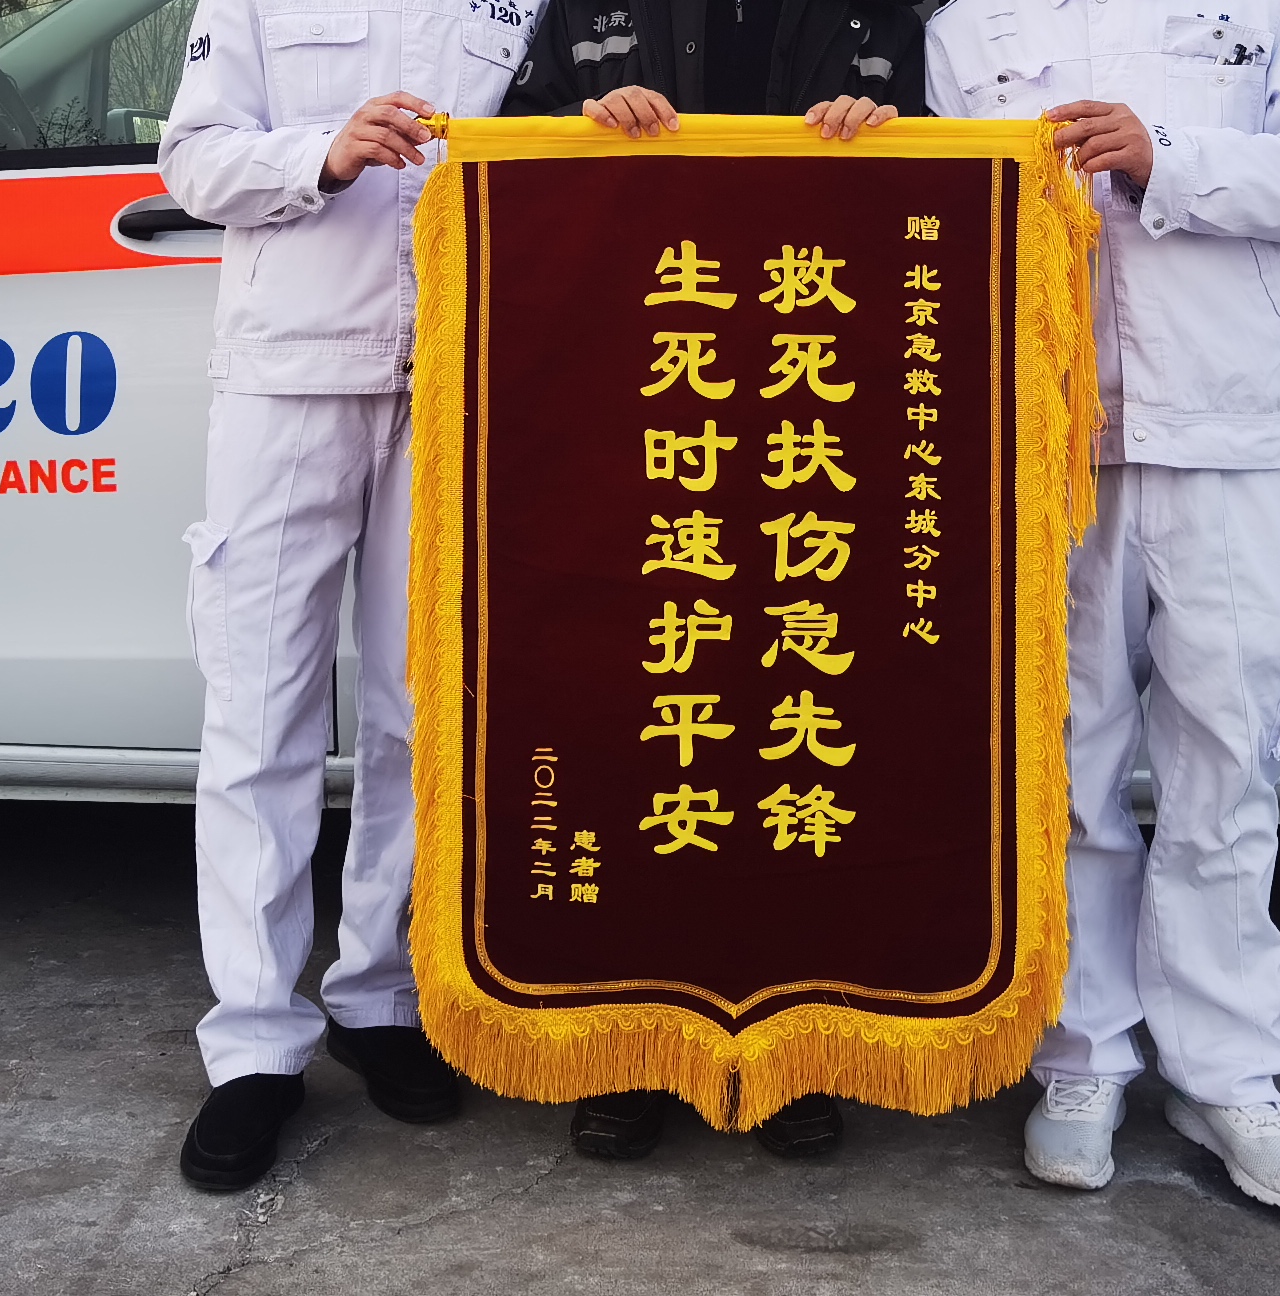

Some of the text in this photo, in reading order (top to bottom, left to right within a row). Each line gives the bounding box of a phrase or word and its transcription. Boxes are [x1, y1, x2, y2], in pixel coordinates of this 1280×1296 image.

[489, 2, 521, 26] 120
[593, 10, 633, 33] 北京
[639, 240, 739, 856] 生死时速护平安
[758, 244, 858, 859] 救死扶伤急先锋
[902, 215, 942, 645] 赠 北京急救中心东城分中心
[569, 830, 601, 904] 患者赠
